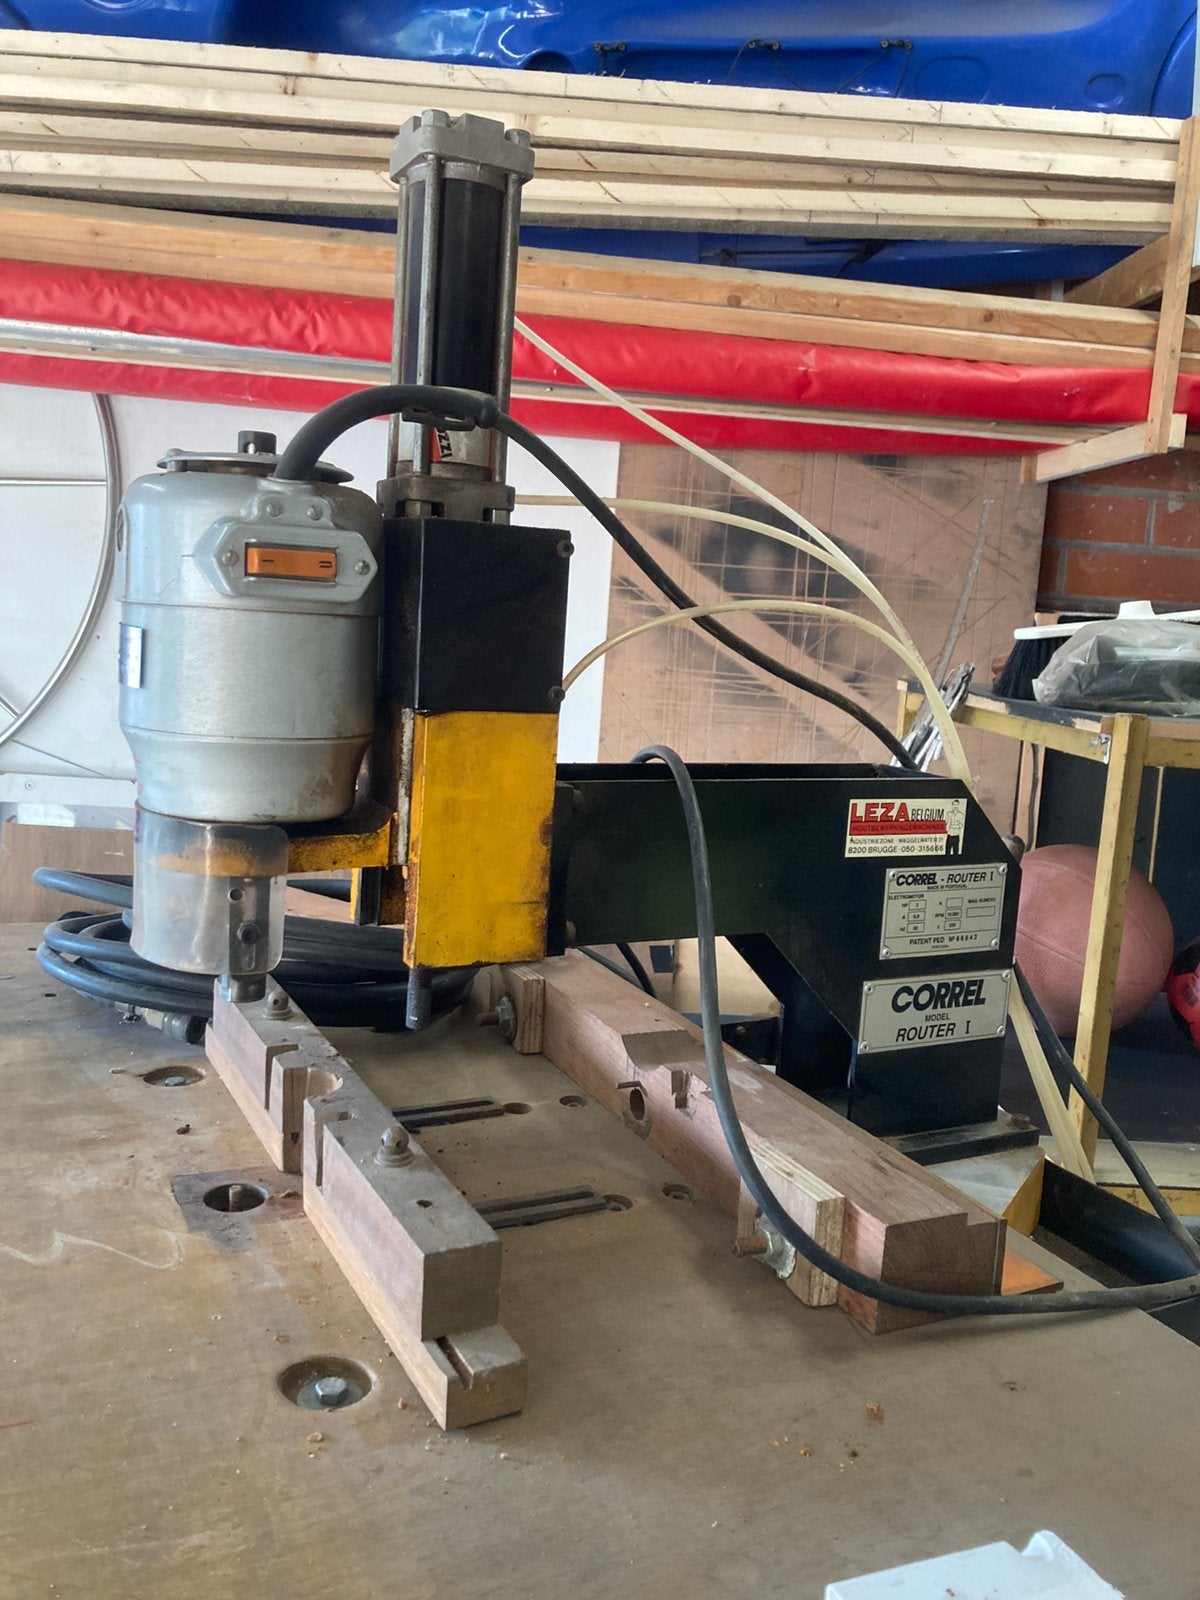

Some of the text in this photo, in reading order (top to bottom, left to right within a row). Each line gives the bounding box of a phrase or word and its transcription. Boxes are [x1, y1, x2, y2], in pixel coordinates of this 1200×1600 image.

[850, 802, 945, 822] LEZA BELGIUM
[852, 824, 946, 833] HOUTBEWERKINGSMACHINES
[848, 846, 867, 854] 8200
[868, 845, 898, 854] BRUGGE
[901, 845, 916, 853] 050
[896, 873, 938, 886] CORREL
[947, 872, 987, 883] ROUTER
[909, 937, 932, 945] PATENT
[891, 979, 986, 1013] CORREL
[925, 1013, 951, 1022] MODEL
[896, 1022, 956, 1042] ROUTER
